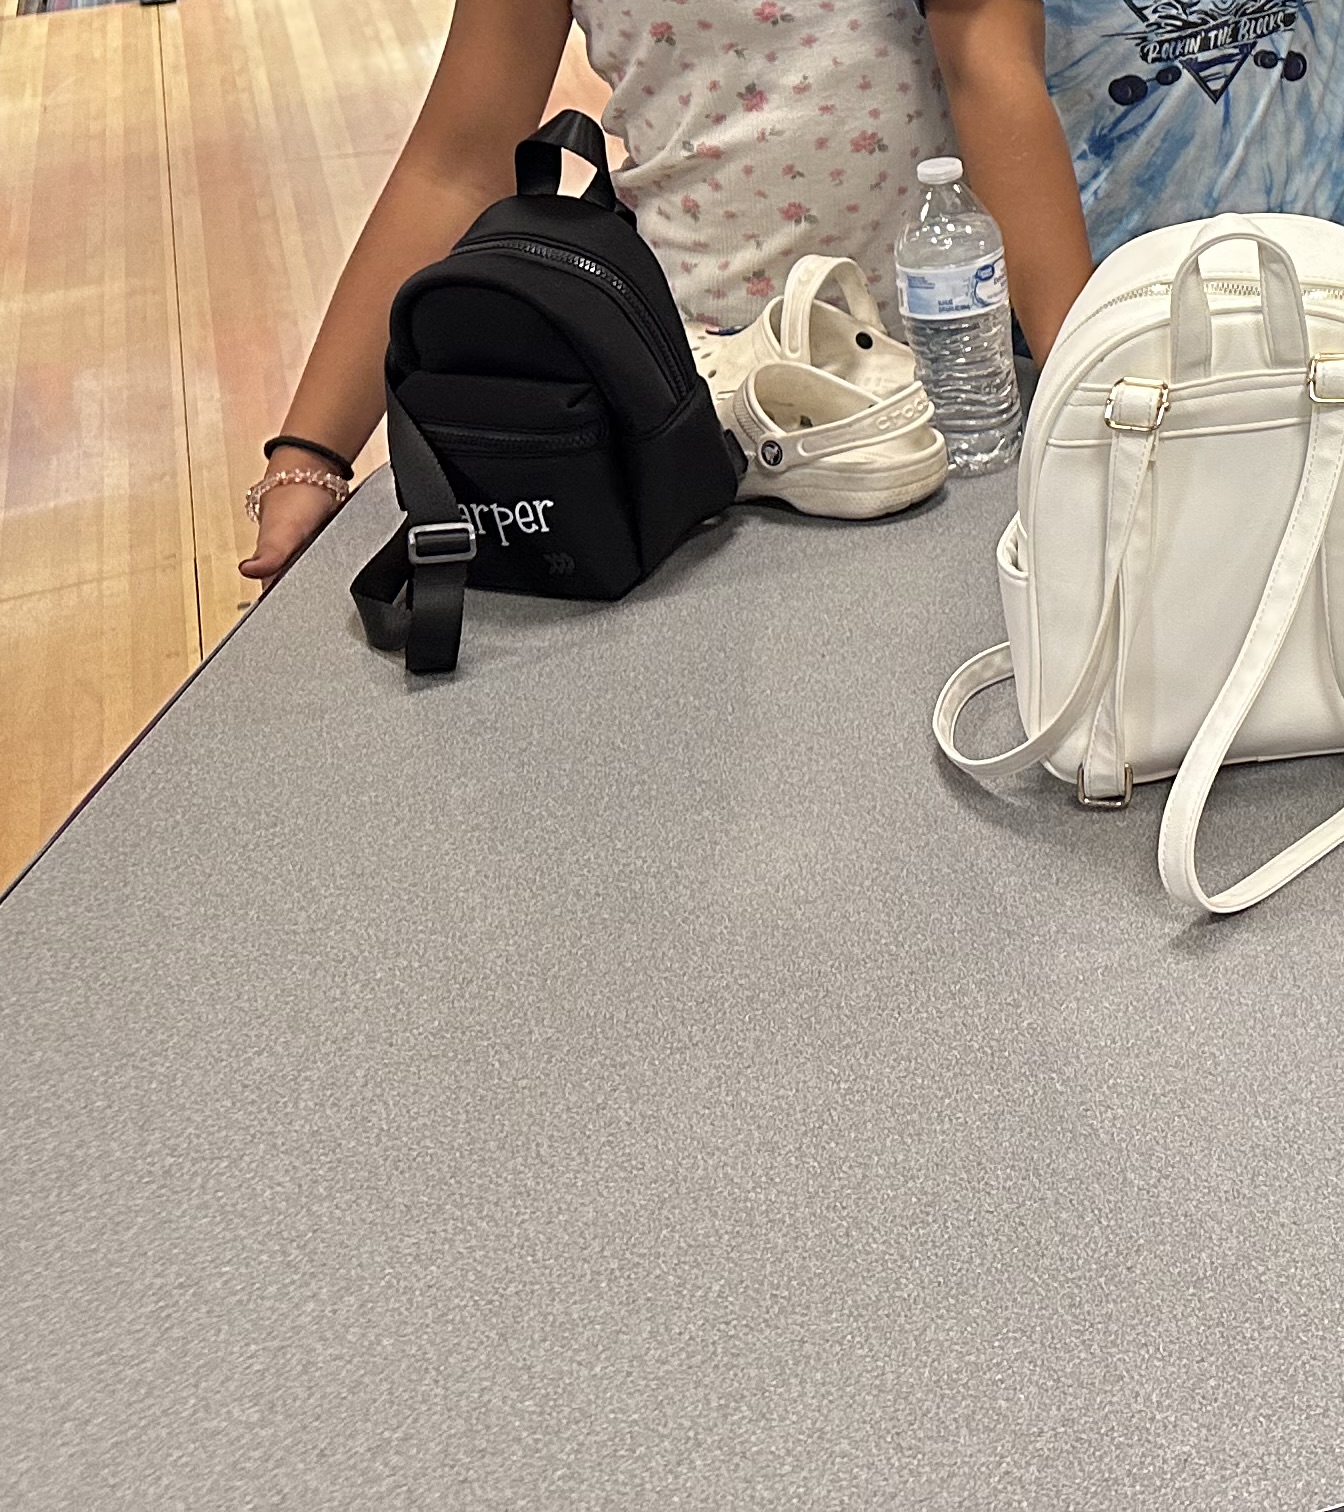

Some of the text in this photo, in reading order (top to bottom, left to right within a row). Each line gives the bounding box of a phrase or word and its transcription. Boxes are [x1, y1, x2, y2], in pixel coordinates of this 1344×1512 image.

[1146, 11, 1284, 60] ROCKIN' THE BLOCKS
